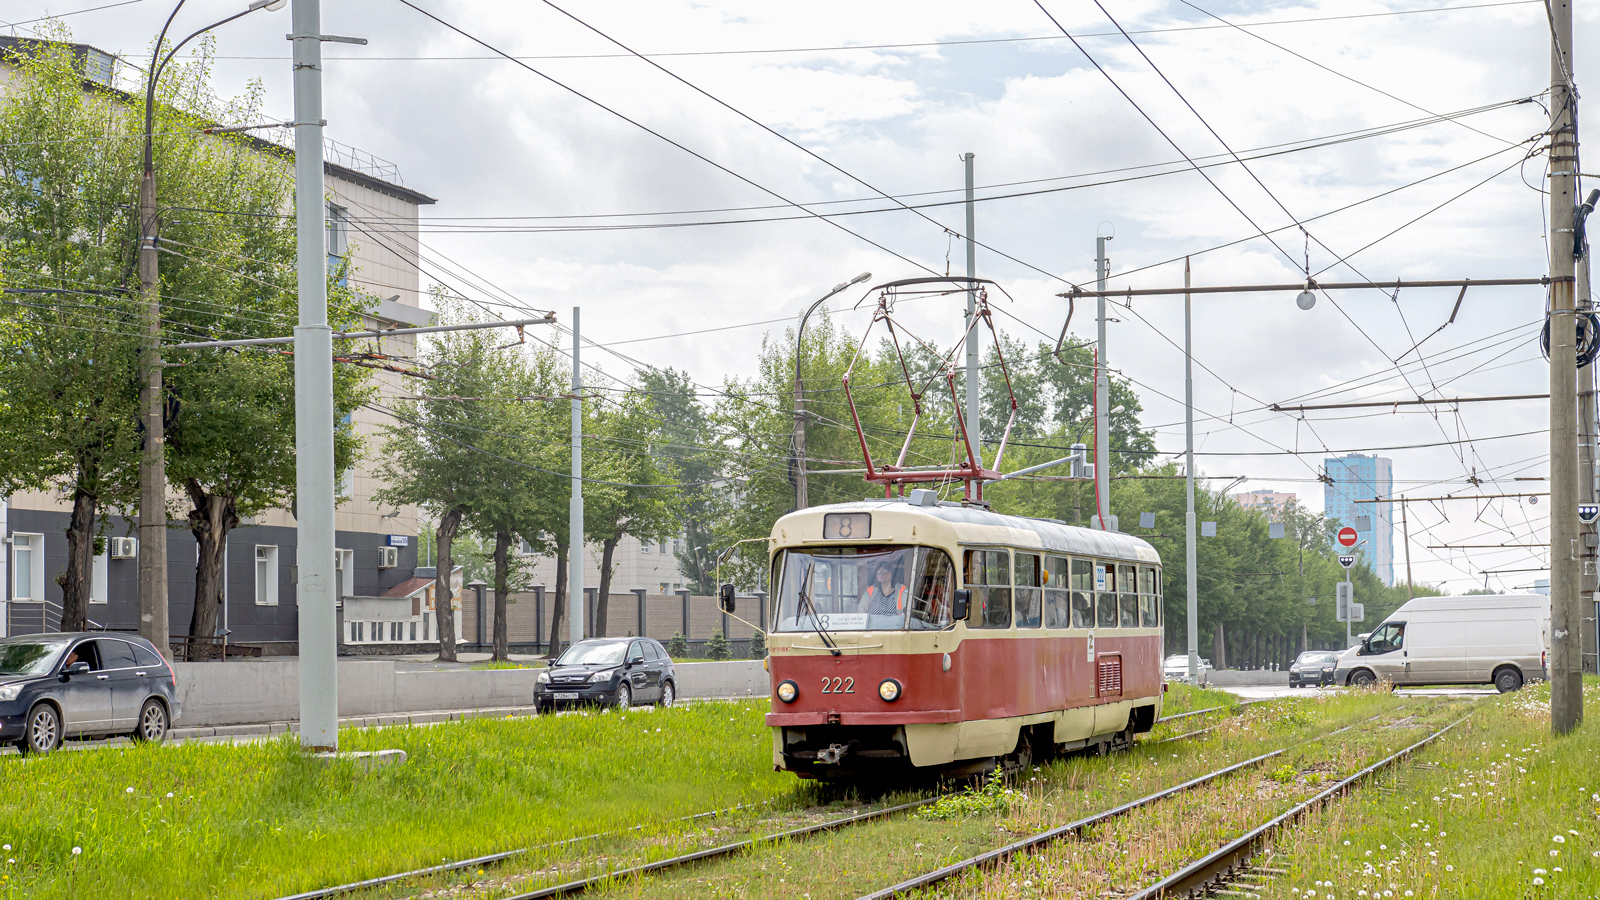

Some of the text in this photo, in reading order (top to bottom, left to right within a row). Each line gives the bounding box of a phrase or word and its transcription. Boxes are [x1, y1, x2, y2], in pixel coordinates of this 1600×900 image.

[839, 516, 852, 538] 8
[818, 614, 830, 630] 8
[822, 676, 855, 694] 222
